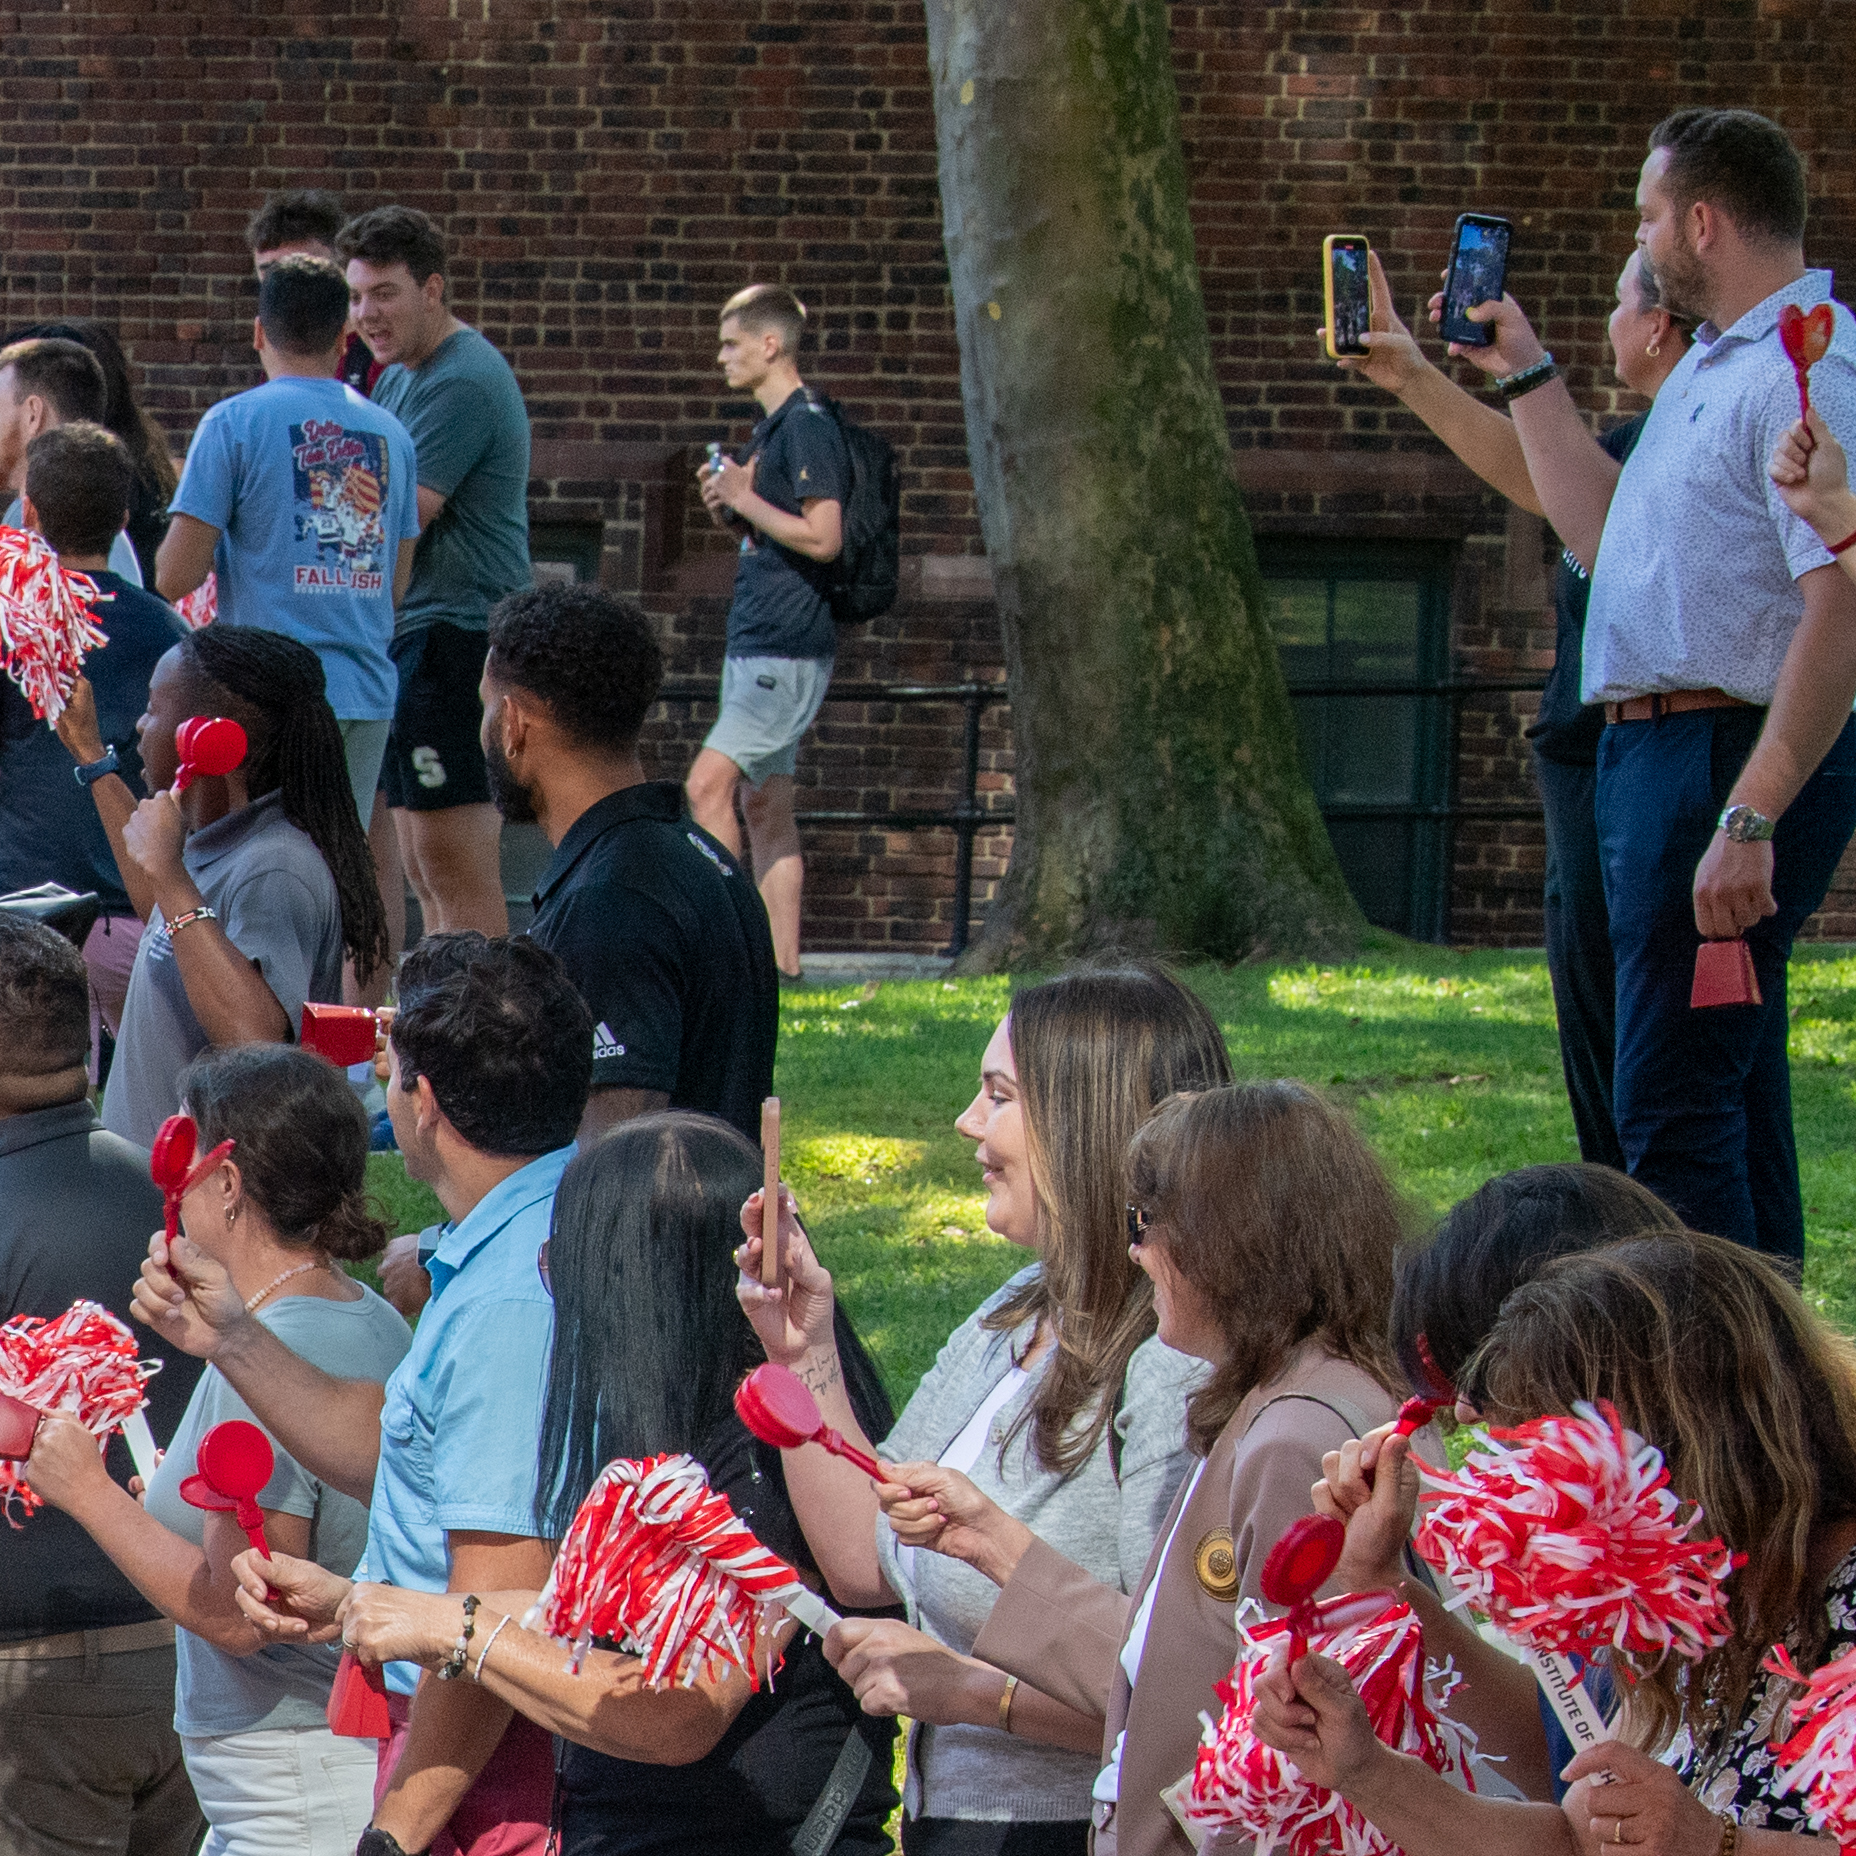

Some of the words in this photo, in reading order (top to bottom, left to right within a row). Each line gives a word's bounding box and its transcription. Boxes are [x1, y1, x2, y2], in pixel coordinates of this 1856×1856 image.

[295, 567, 347, 586] FALL
[411, 746, 447, 788] S
[1574, 1720, 1596, 1742] OF
